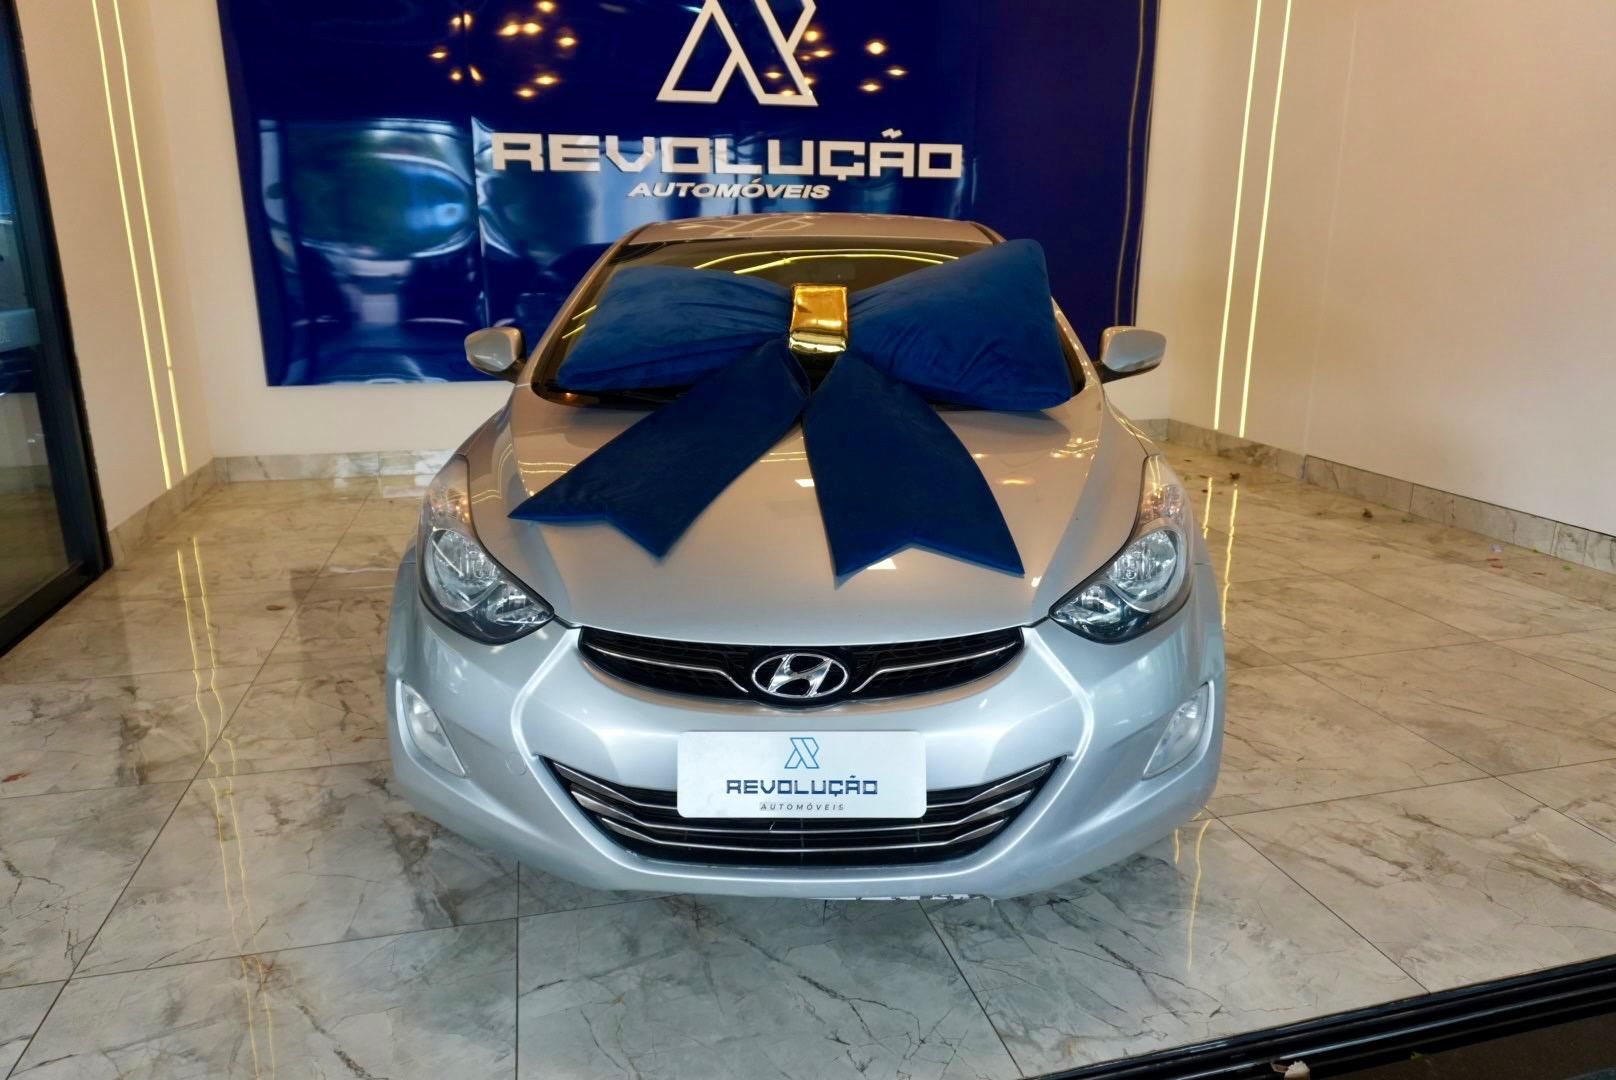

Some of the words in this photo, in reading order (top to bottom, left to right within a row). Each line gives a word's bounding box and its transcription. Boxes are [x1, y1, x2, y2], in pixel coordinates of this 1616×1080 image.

[492, 128, 963, 181] REVOLUÇÃO
[628, 178, 831, 200] AUTOMÓVEIS
[726, 775, 878, 797] REVOLUÇÃO
[760, 802, 844, 811] AUTOMÓVEIS
